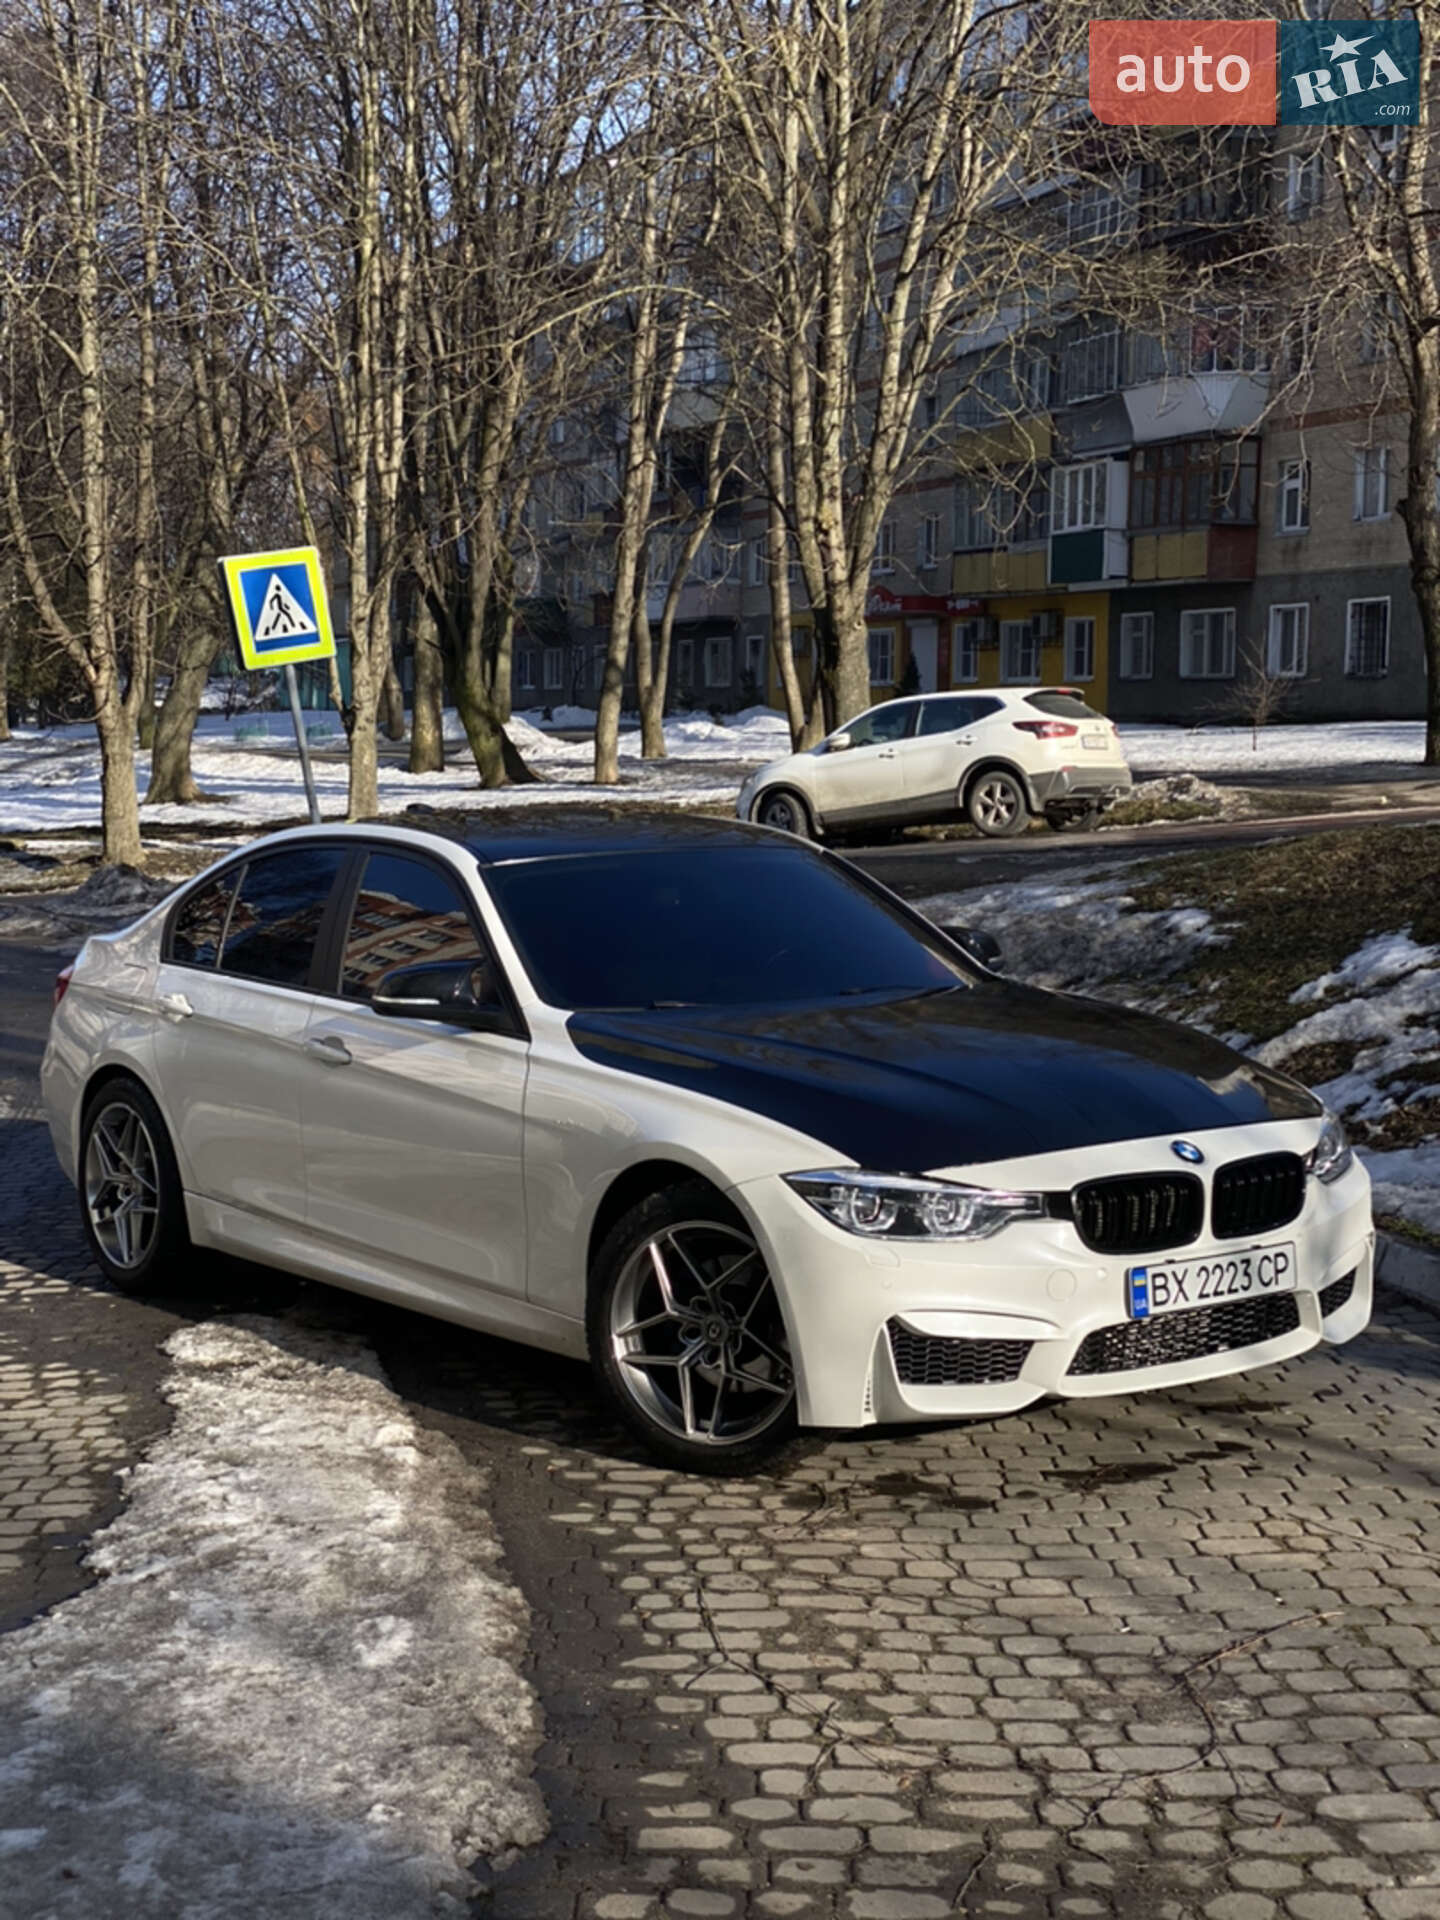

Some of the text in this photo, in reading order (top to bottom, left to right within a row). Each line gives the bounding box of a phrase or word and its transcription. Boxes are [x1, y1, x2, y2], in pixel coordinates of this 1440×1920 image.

[1151, 1251, 1289, 1307] BX 2223 CP
